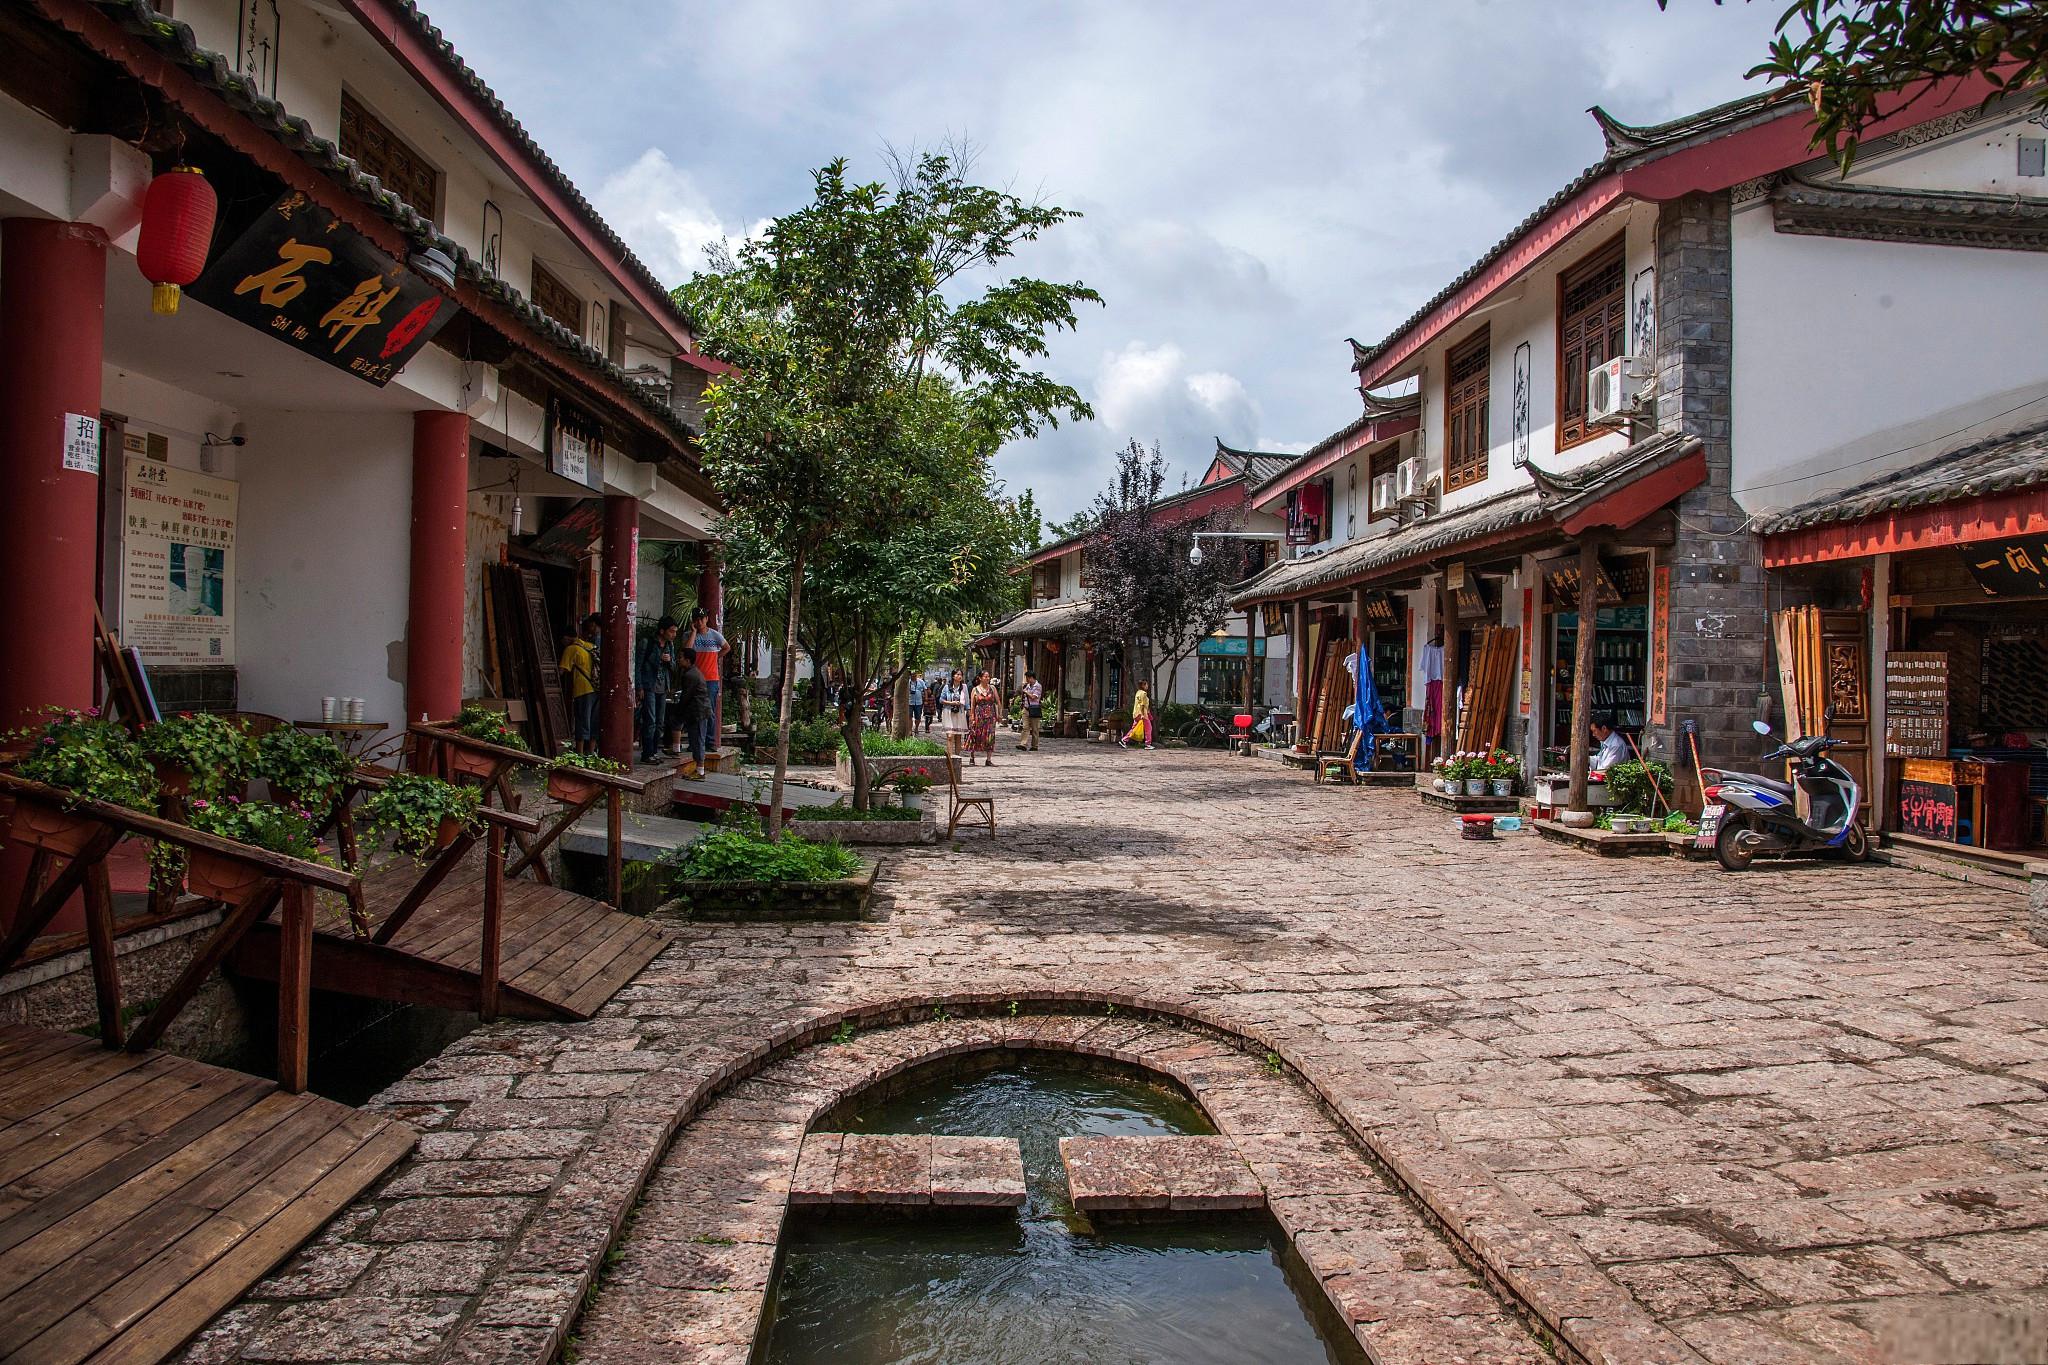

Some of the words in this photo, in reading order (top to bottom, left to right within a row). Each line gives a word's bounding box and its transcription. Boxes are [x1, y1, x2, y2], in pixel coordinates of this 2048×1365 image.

[271, 314, 293, 333] Shi
[292, 326, 309, 341] Hu
[77, 417, 94, 439] 招
[130, 486, 153, 501] 到丽江
